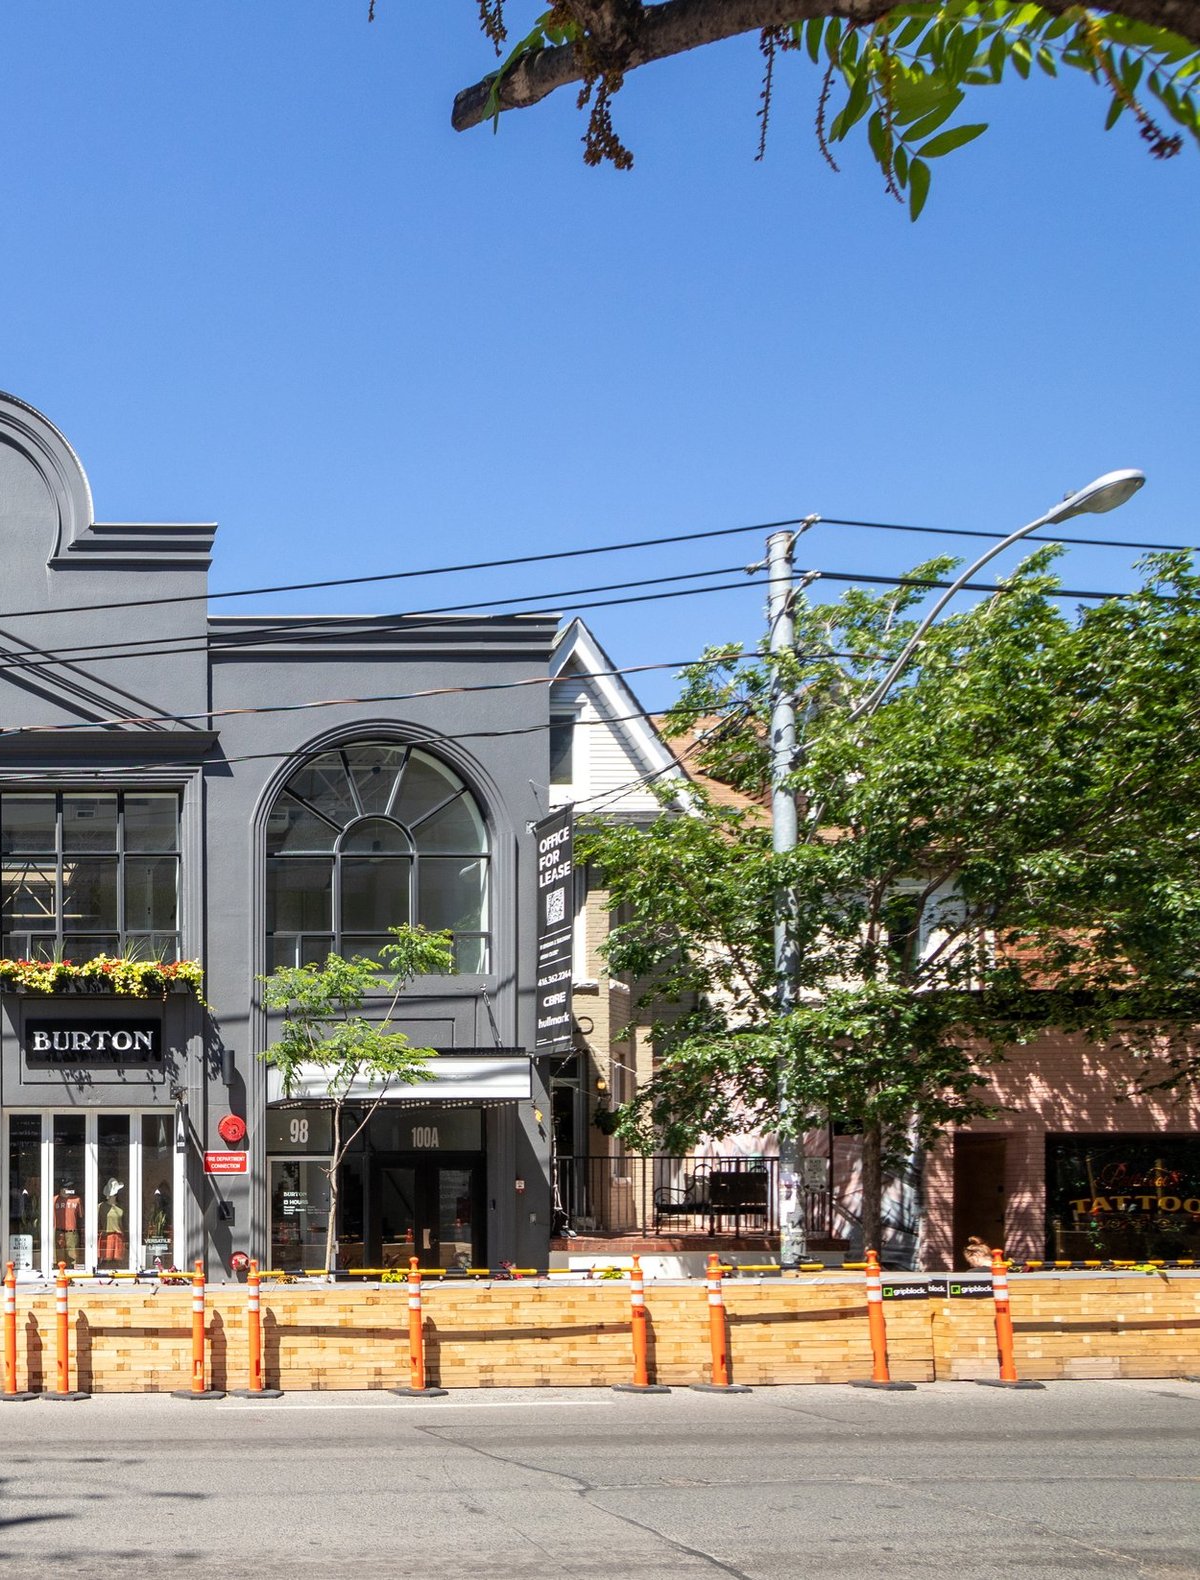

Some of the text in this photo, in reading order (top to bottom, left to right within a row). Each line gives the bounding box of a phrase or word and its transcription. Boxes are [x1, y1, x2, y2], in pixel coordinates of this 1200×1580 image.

[539, 826, 569, 853] OFFICE
[539, 849, 560, 871] FOR
[539, 860, 571, 888] LEASE
[543, 991, 566, 1007] CBRE
[538, 1011, 569, 1028] hullmark
[32, 1030, 154, 1051] BURTON
[290, 1118, 309, 1143] 98
[411, 1126, 439, 1148] 100A
